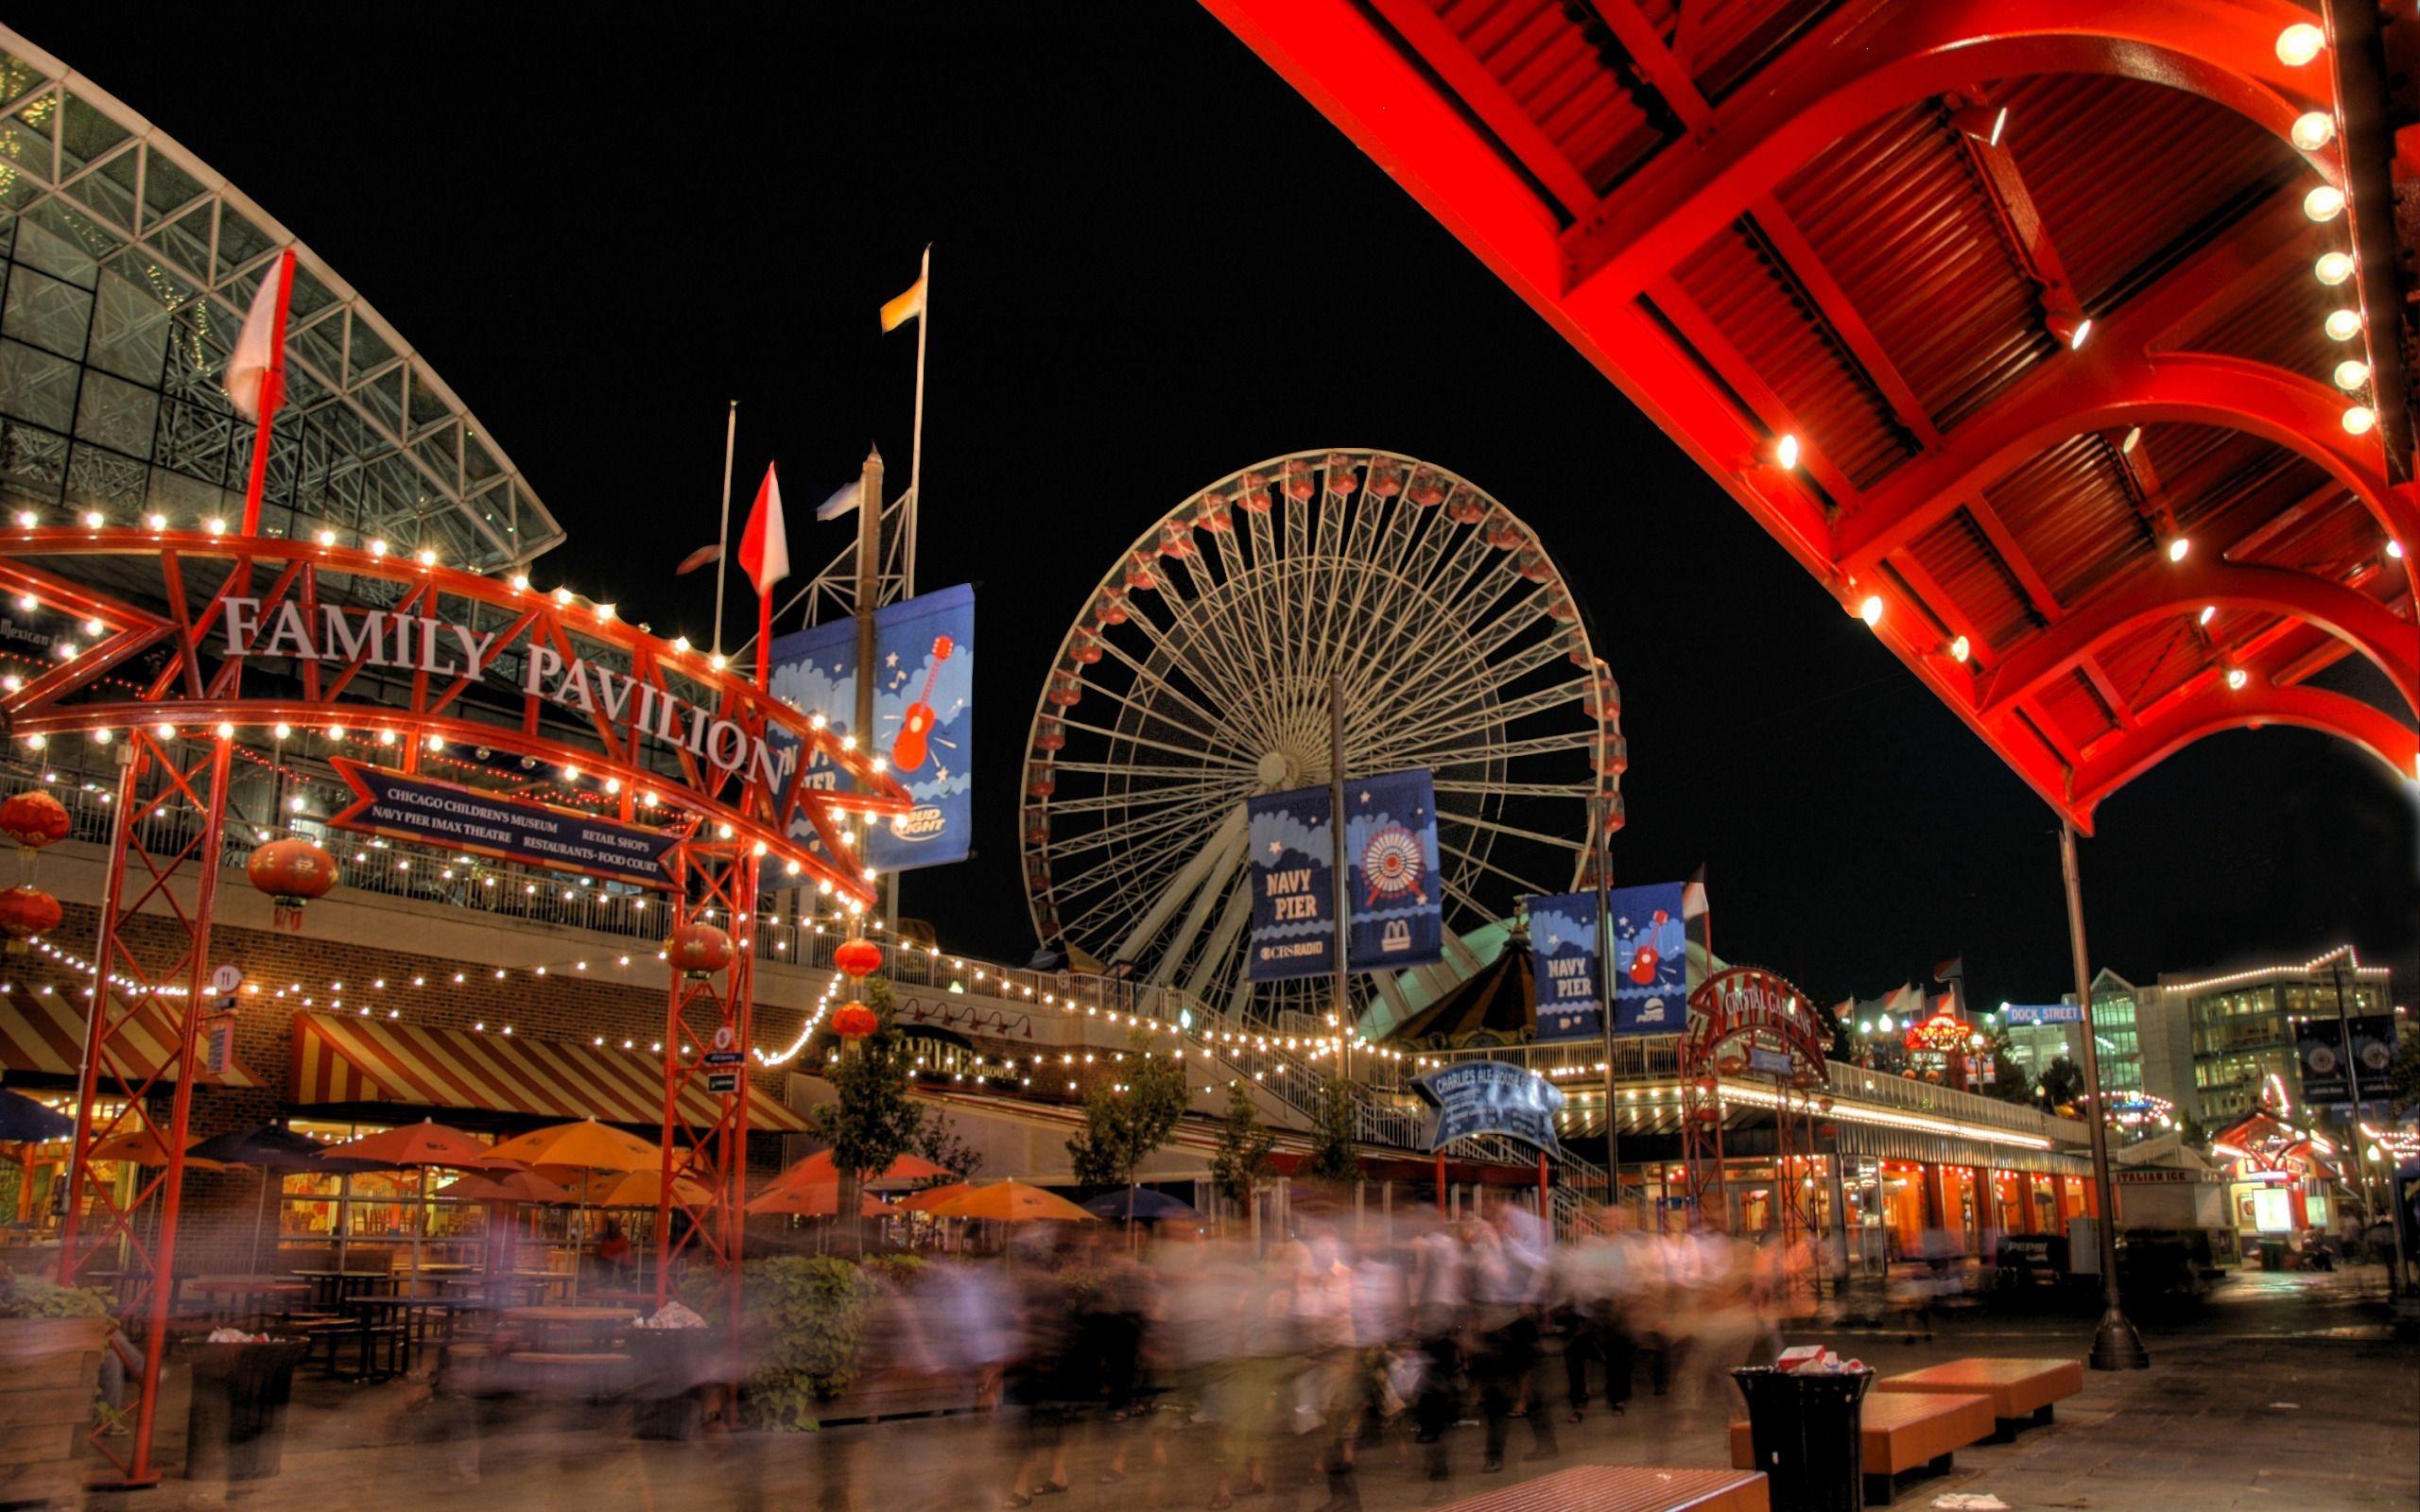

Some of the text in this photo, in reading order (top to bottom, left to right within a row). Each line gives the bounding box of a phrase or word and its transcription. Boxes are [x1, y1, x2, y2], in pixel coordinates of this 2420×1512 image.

[1, 618, 48, 646] Mexican
[219, 596, 789, 795] FAMILY PAVILION
[388, 787, 558, 833] CHICAGO CHILDREN'S MUSEUM
[372, 805, 512, 843] NAVY PIER IMAX THEATRE
[582, 830, 649, 852] RETAIL SHOPS
[598, 851, 626, 867] FOOD
[627, 857, 659, 872] COURT
[1266, 868, 1311, 896] NAVY
[1275, 895, 1317, 920] PIER
[1547, 957, 1586, 978] NAVY
[1558, 977, 1592, 997] PIER
[1725, 985, 1766, 1015] CRYSTAL
[2012, 1007, 2077, 1021] DOCK STREET
[2117, 1172, 2186, 1182] ITALIAN ICE
